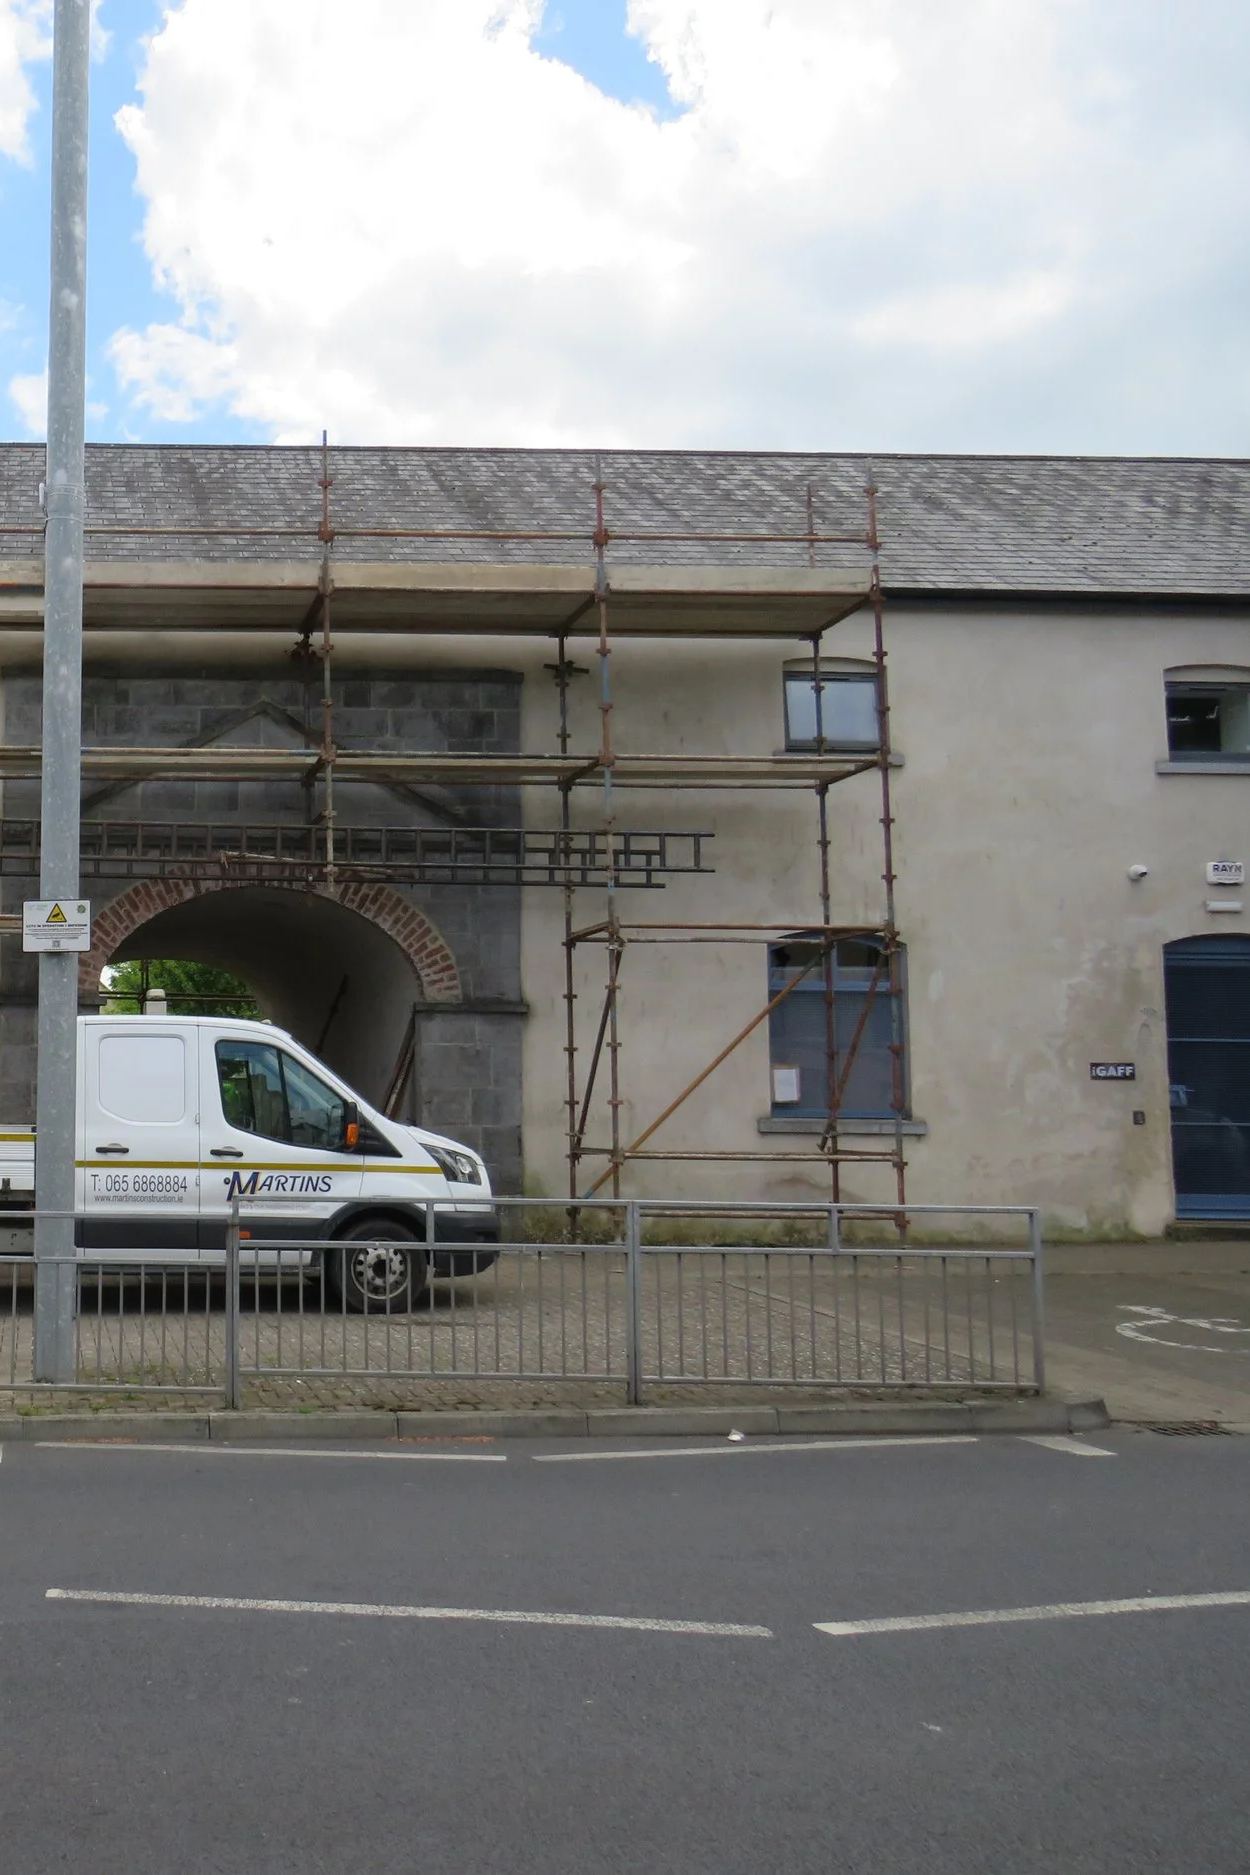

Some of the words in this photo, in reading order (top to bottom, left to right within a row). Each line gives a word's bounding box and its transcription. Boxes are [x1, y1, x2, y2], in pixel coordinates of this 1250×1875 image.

[91, 1174, 101, 1191] T:
[105, 1174, 129, 1192] 065
[133, 1174, 187, 1193] 6868884
[226, 1171, 332, 1202] MARTINS
[94, 1194, 184, 1203] www.martinsconstruction.ie
